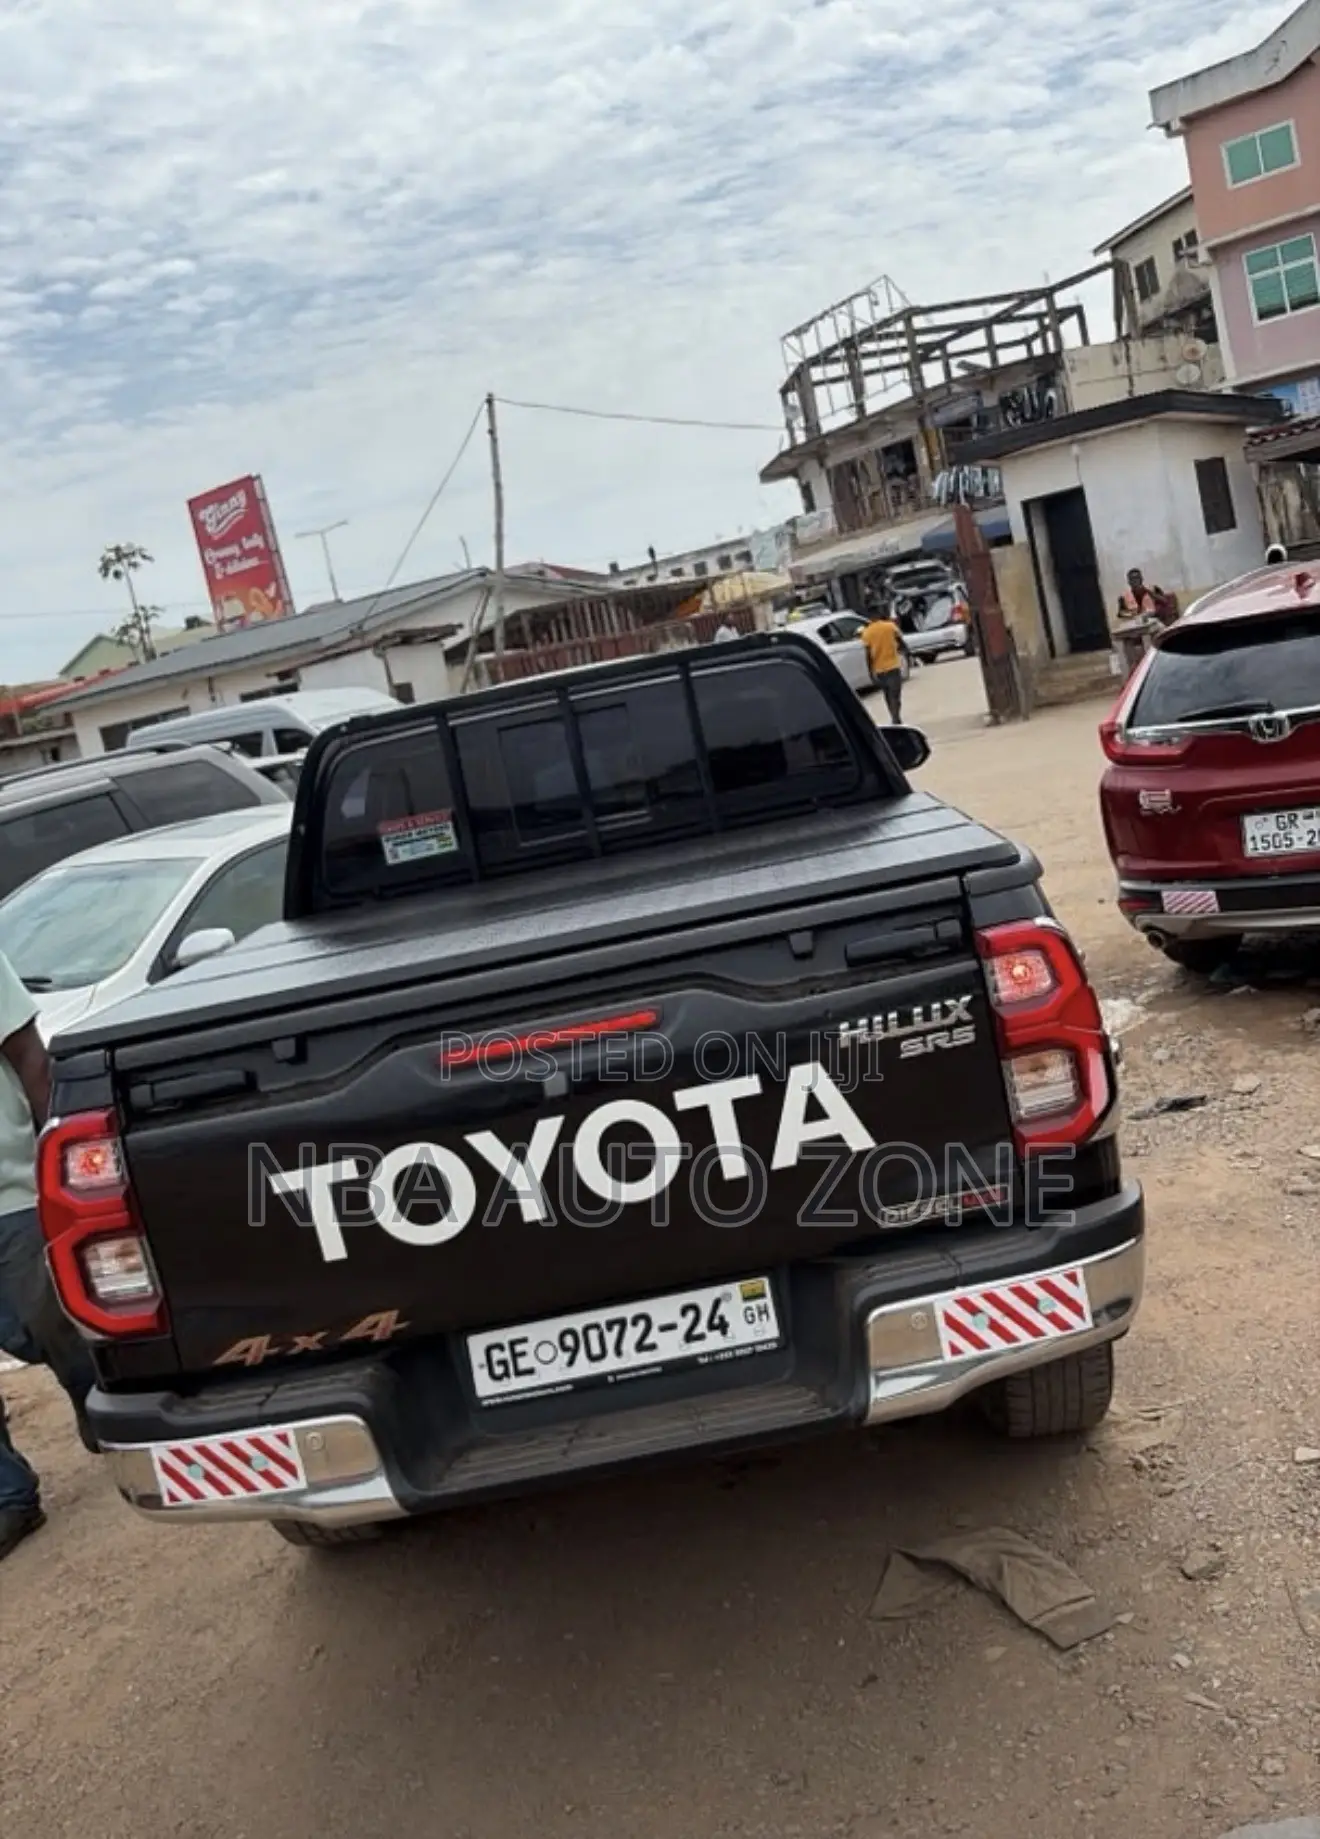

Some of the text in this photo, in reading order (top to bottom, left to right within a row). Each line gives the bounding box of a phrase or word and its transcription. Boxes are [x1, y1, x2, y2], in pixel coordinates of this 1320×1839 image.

[1250, 828, 1320, 851] 1505-2
[1275, 813, 1300, 831] GR
[839, 995, 973, 1048] HILUX
[269, 1061, 877, 1263] TOYOTA
[743, 1302, 770, 1325] GH
[484, 1296, 730, 1381] GE 9072-24
